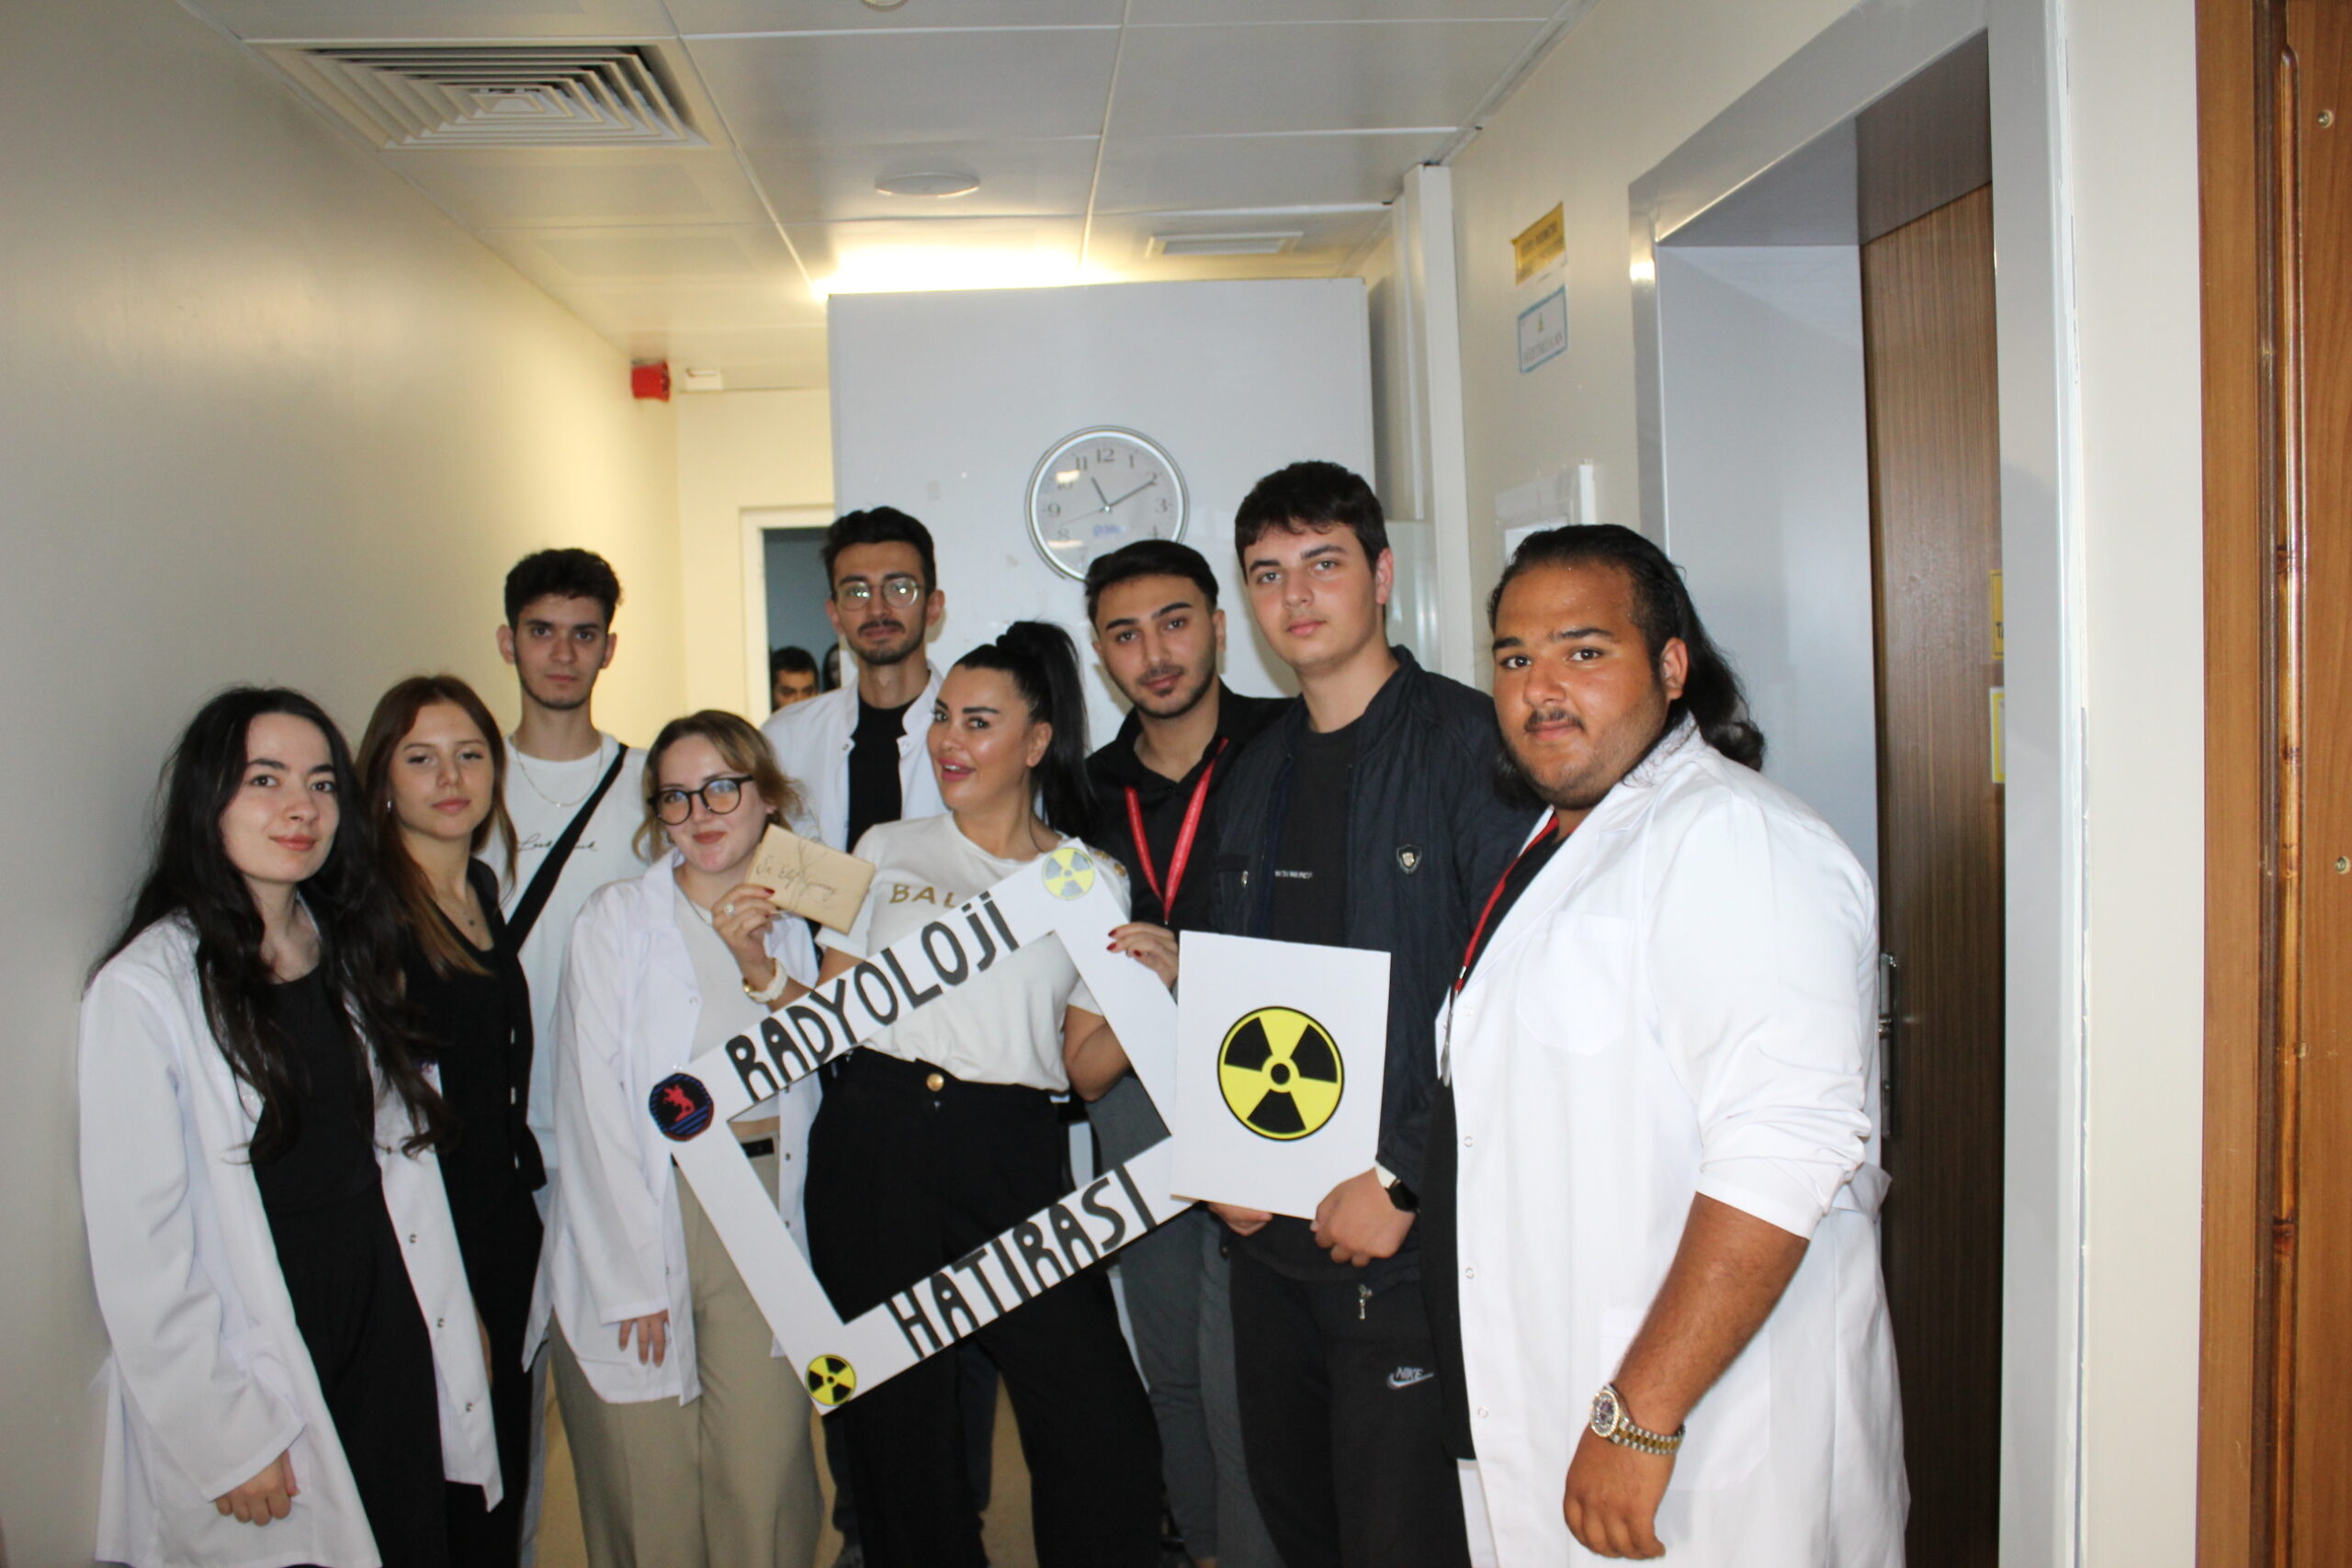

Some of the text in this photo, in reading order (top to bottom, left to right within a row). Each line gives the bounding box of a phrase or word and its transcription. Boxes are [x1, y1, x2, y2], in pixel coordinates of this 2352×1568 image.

[1096, 447, 1115, 463] 12
[1075, 457, 1089, 470] 11
[1146, 470, 1158, 486] 2
[1046, 502, 1061, 518] 9
[1154, 497, 1169, 514] 3
[885, 1164, 1158, 1359] HATIRASI
[1396, 1366, 1424, 1381] NIKE
